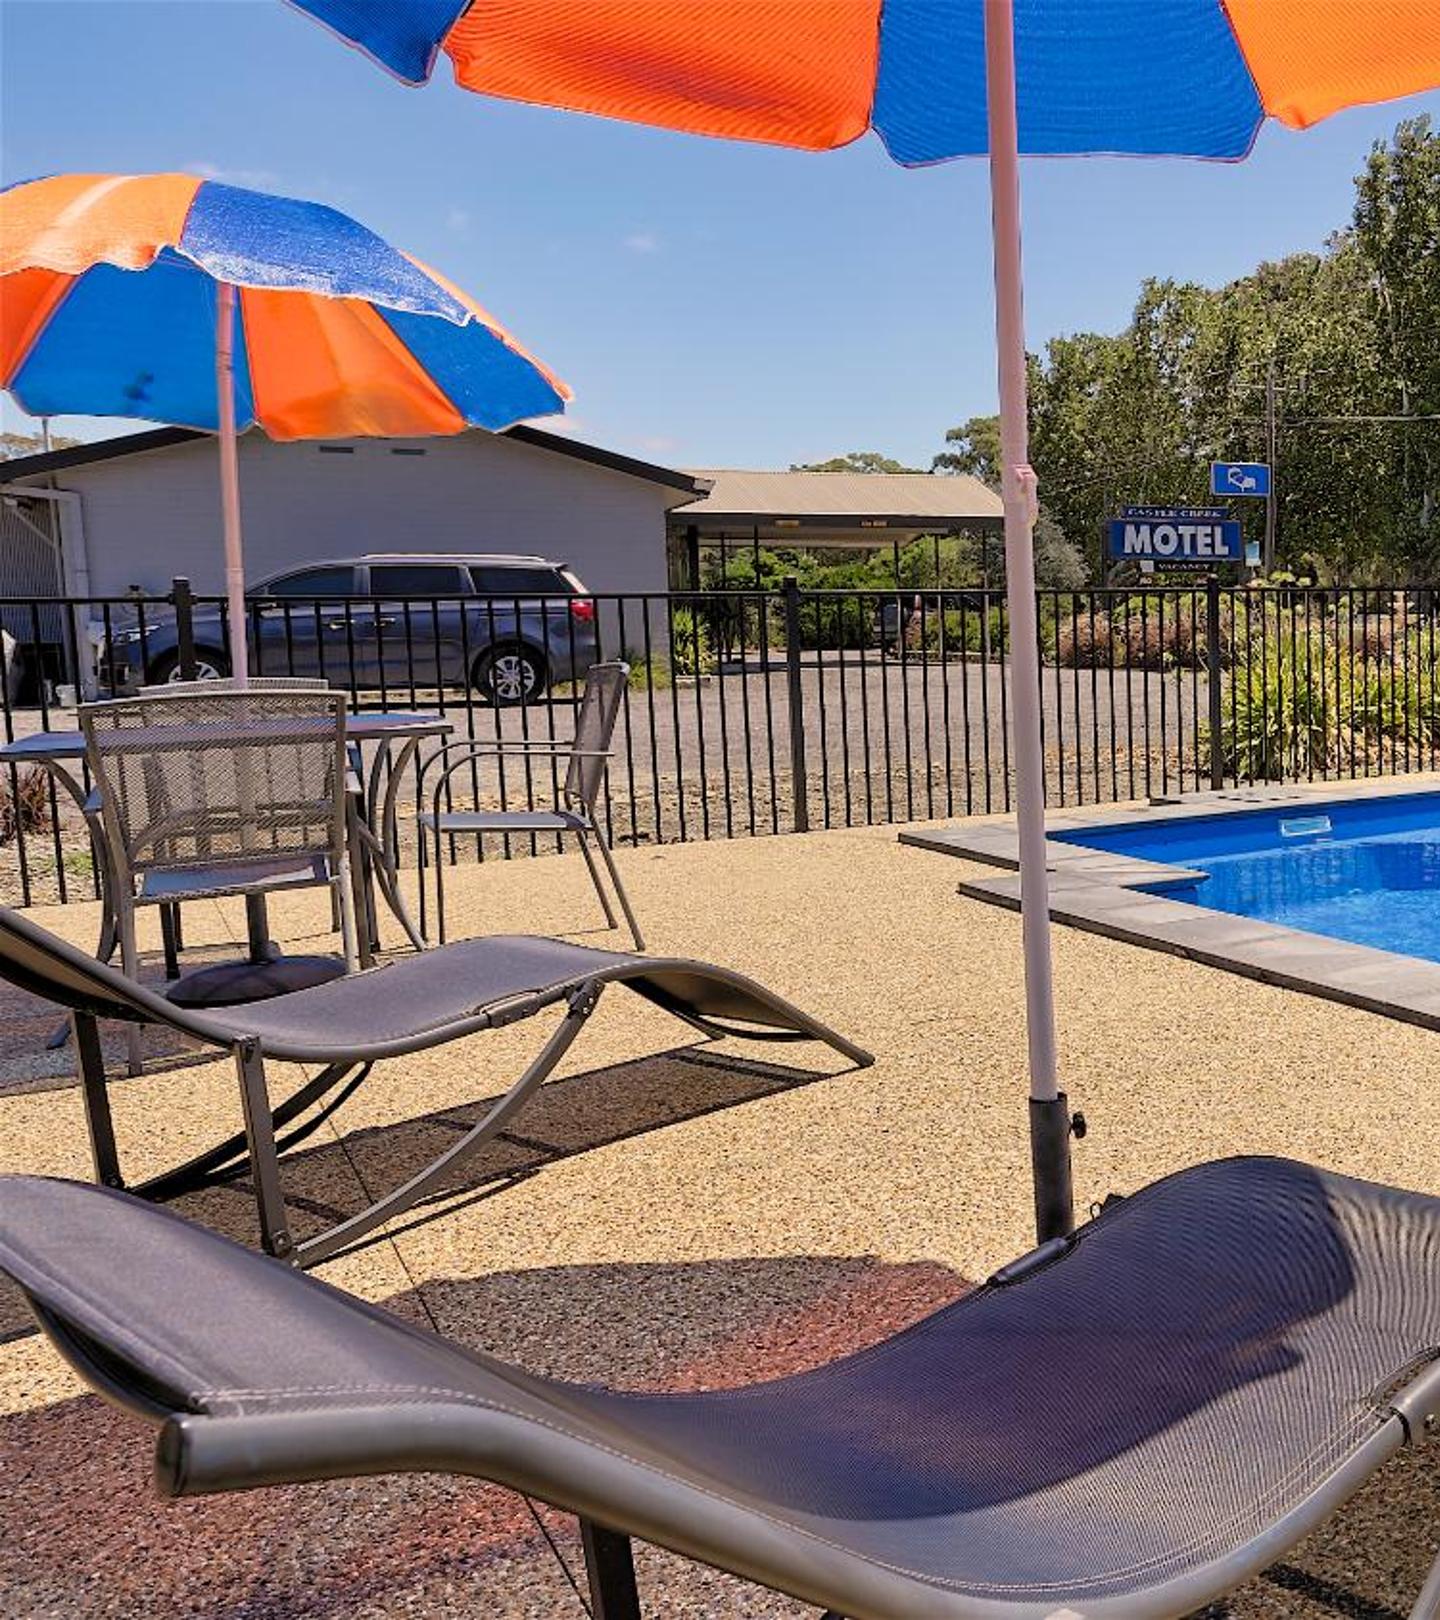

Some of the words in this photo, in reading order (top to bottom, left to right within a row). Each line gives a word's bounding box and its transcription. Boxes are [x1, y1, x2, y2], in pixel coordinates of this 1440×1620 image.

[1128, 508, 1177, 517] CASTLE
[1180, 509, 1221, 517] CREEK
[1124, 524, 1229, 555] MOTEL
